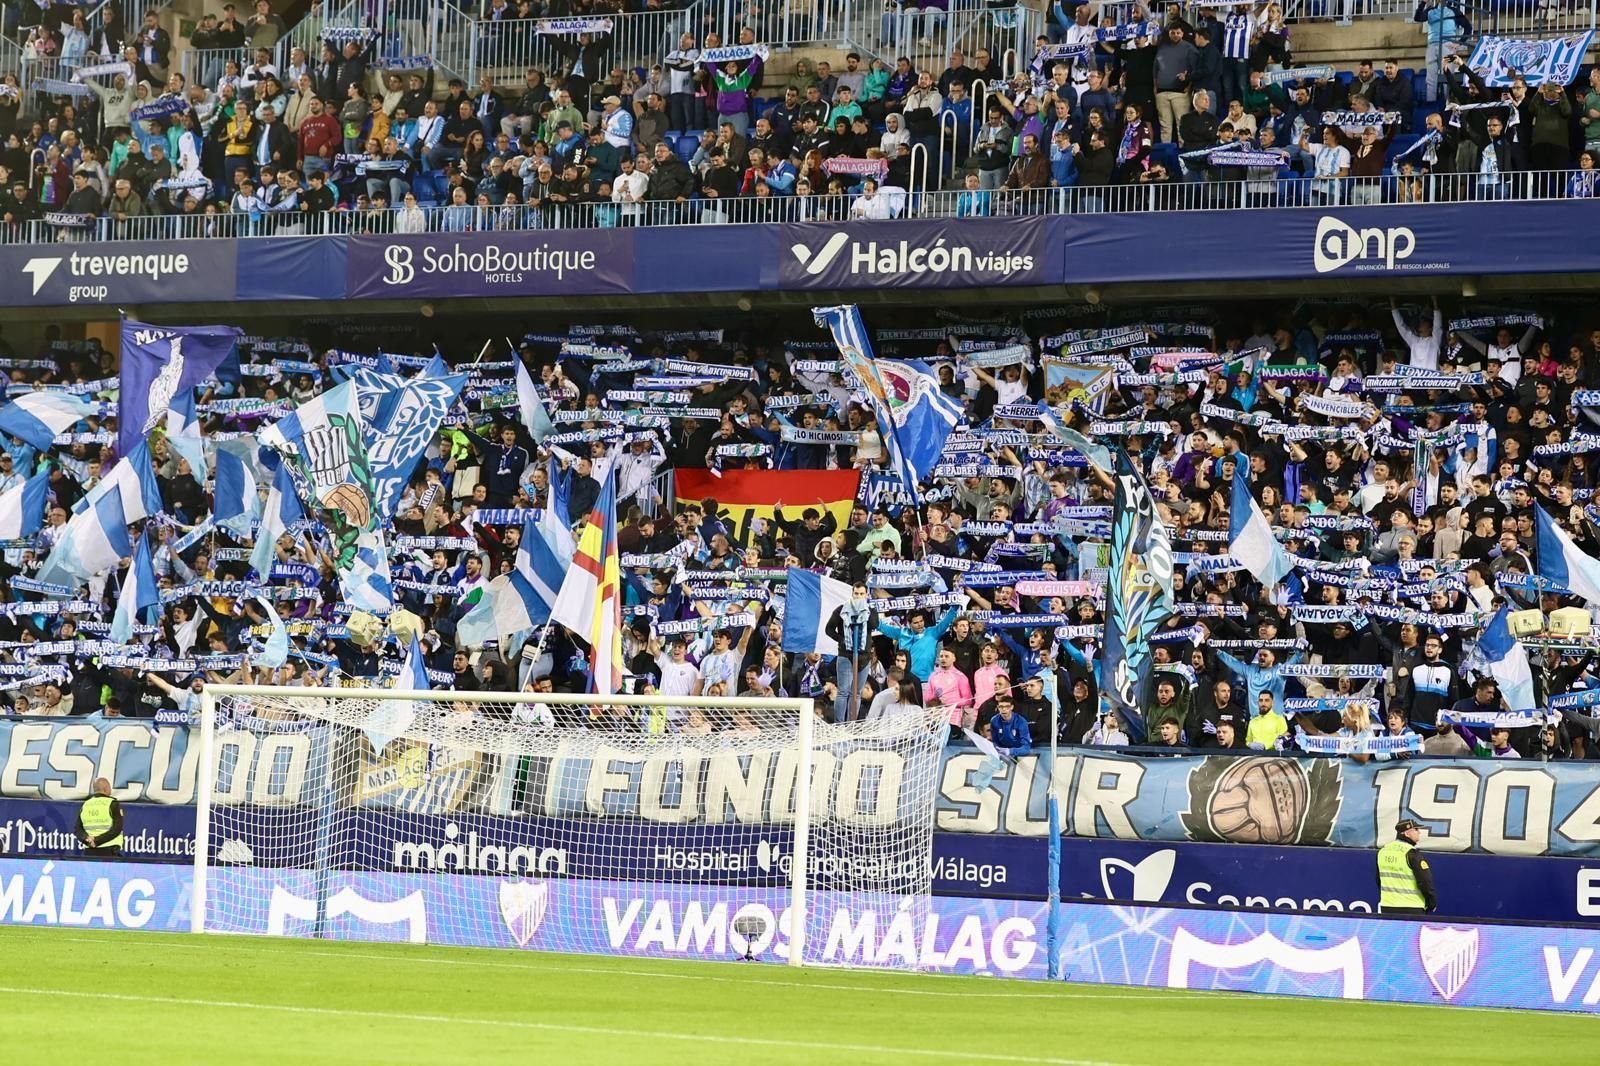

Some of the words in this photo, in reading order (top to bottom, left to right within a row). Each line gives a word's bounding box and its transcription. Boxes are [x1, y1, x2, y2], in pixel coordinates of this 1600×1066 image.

[707, 47, 752, 59] MALAGA
[1336, 113, 1383, 124] MALAGA
[422, 243, 596, 281] SohoBoutique
[851, 238, 972, 274] Halcón
[975, 253, 1034, 276] viajes
[69, 251, 189, 280] trevenque
[485, 273, 523, 283] HOTELS
[69, 284, 108, 302] group
[797, 360, 836, 371] FONDO
[1399, 364, 1440, 377] FONDO
[1120, 374, 1156, 385] FONDO
[1310, 400, 1359, 414] INVENCIBLES
[556, 410, 589, 421] FONDO
[602, 410, 624, 421] SUR
[550, 431, 583, 444] ONDO
[793, 431, 807, 441] ¡LO
[808, 431, 843, 442] HICIMOS!
[946, 466, 978, 476] PADRES
[478, 509, 542, 523] MALAGA
[966, 521, 1006, 530] MALAGA
[405, 537, 436, 548] PADRES
[878, 559, 916, 568] MALAGA
[931, 554, 971, 571] PADRES
[275, 564, 306, 575] MALAGA
[972, 571, 1040, 585] MALAGA
[742, 586, 767, 599] SUR
[1017, 582, 1080, 594] MALAGUISTA
[23, 601, 59, 612] PADRES
[877, 599, 915, 613] PADRES
[658, 620, 698, 634] FONDO
[722, 613, 748, 627] SUR
[43, 641, 75, 653] PADRES
[156, 659, 197, 670] PADRES
[1286, 664, 1330, 676] FONDO
[1348, 664, 1378, 676] SUR
[1285, 700, 1319, 709] MALAKA
[1552, 695, 1578, 707] MALAKA
[1465, 711, 1525, 724] MALAGA
[1305, 738, 1341, 750] MALAKA
[1367, 738, 1410, 750] HINCHAS
[1, 723, 312, 808] ESCUDO
[585, 744, 906, 827] FONDO
[935, 752, 1148, 840] SUR
[655, 844, 748, 876] Hospital
[929, 856, 1008, 888] Málaga
[602, 896, 809, 958] VAMOS
